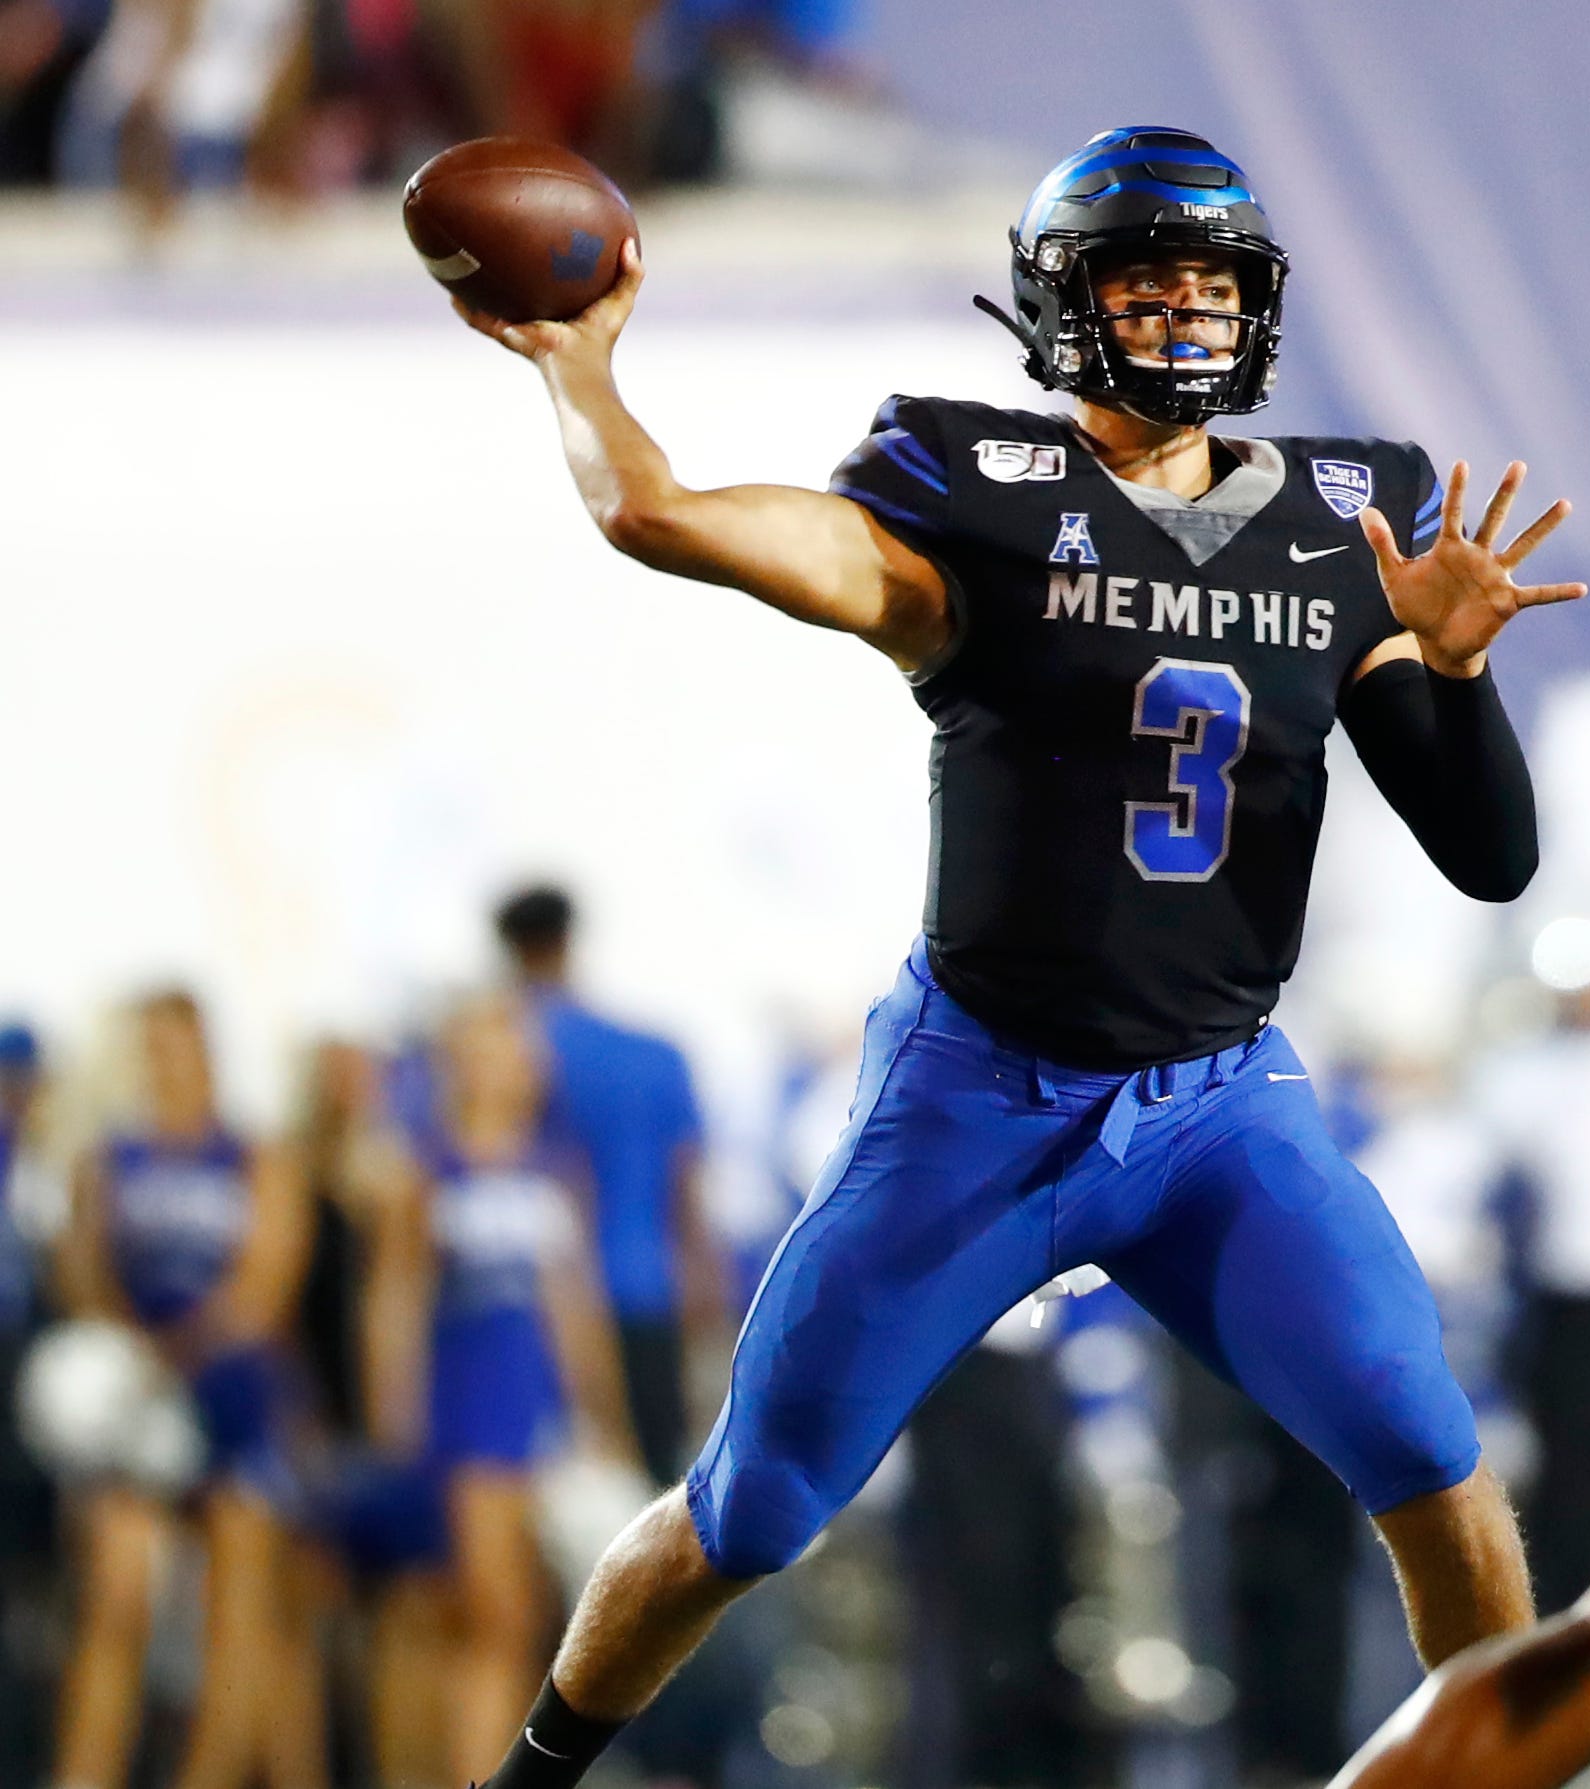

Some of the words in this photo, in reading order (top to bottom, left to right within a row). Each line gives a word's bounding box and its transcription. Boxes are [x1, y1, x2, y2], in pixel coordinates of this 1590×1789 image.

[1179, 201, 1229, 221] Tigers
[1042, 571, 1336, 651] MEMPHIS
[1124, 656, 1252, 882] 3
